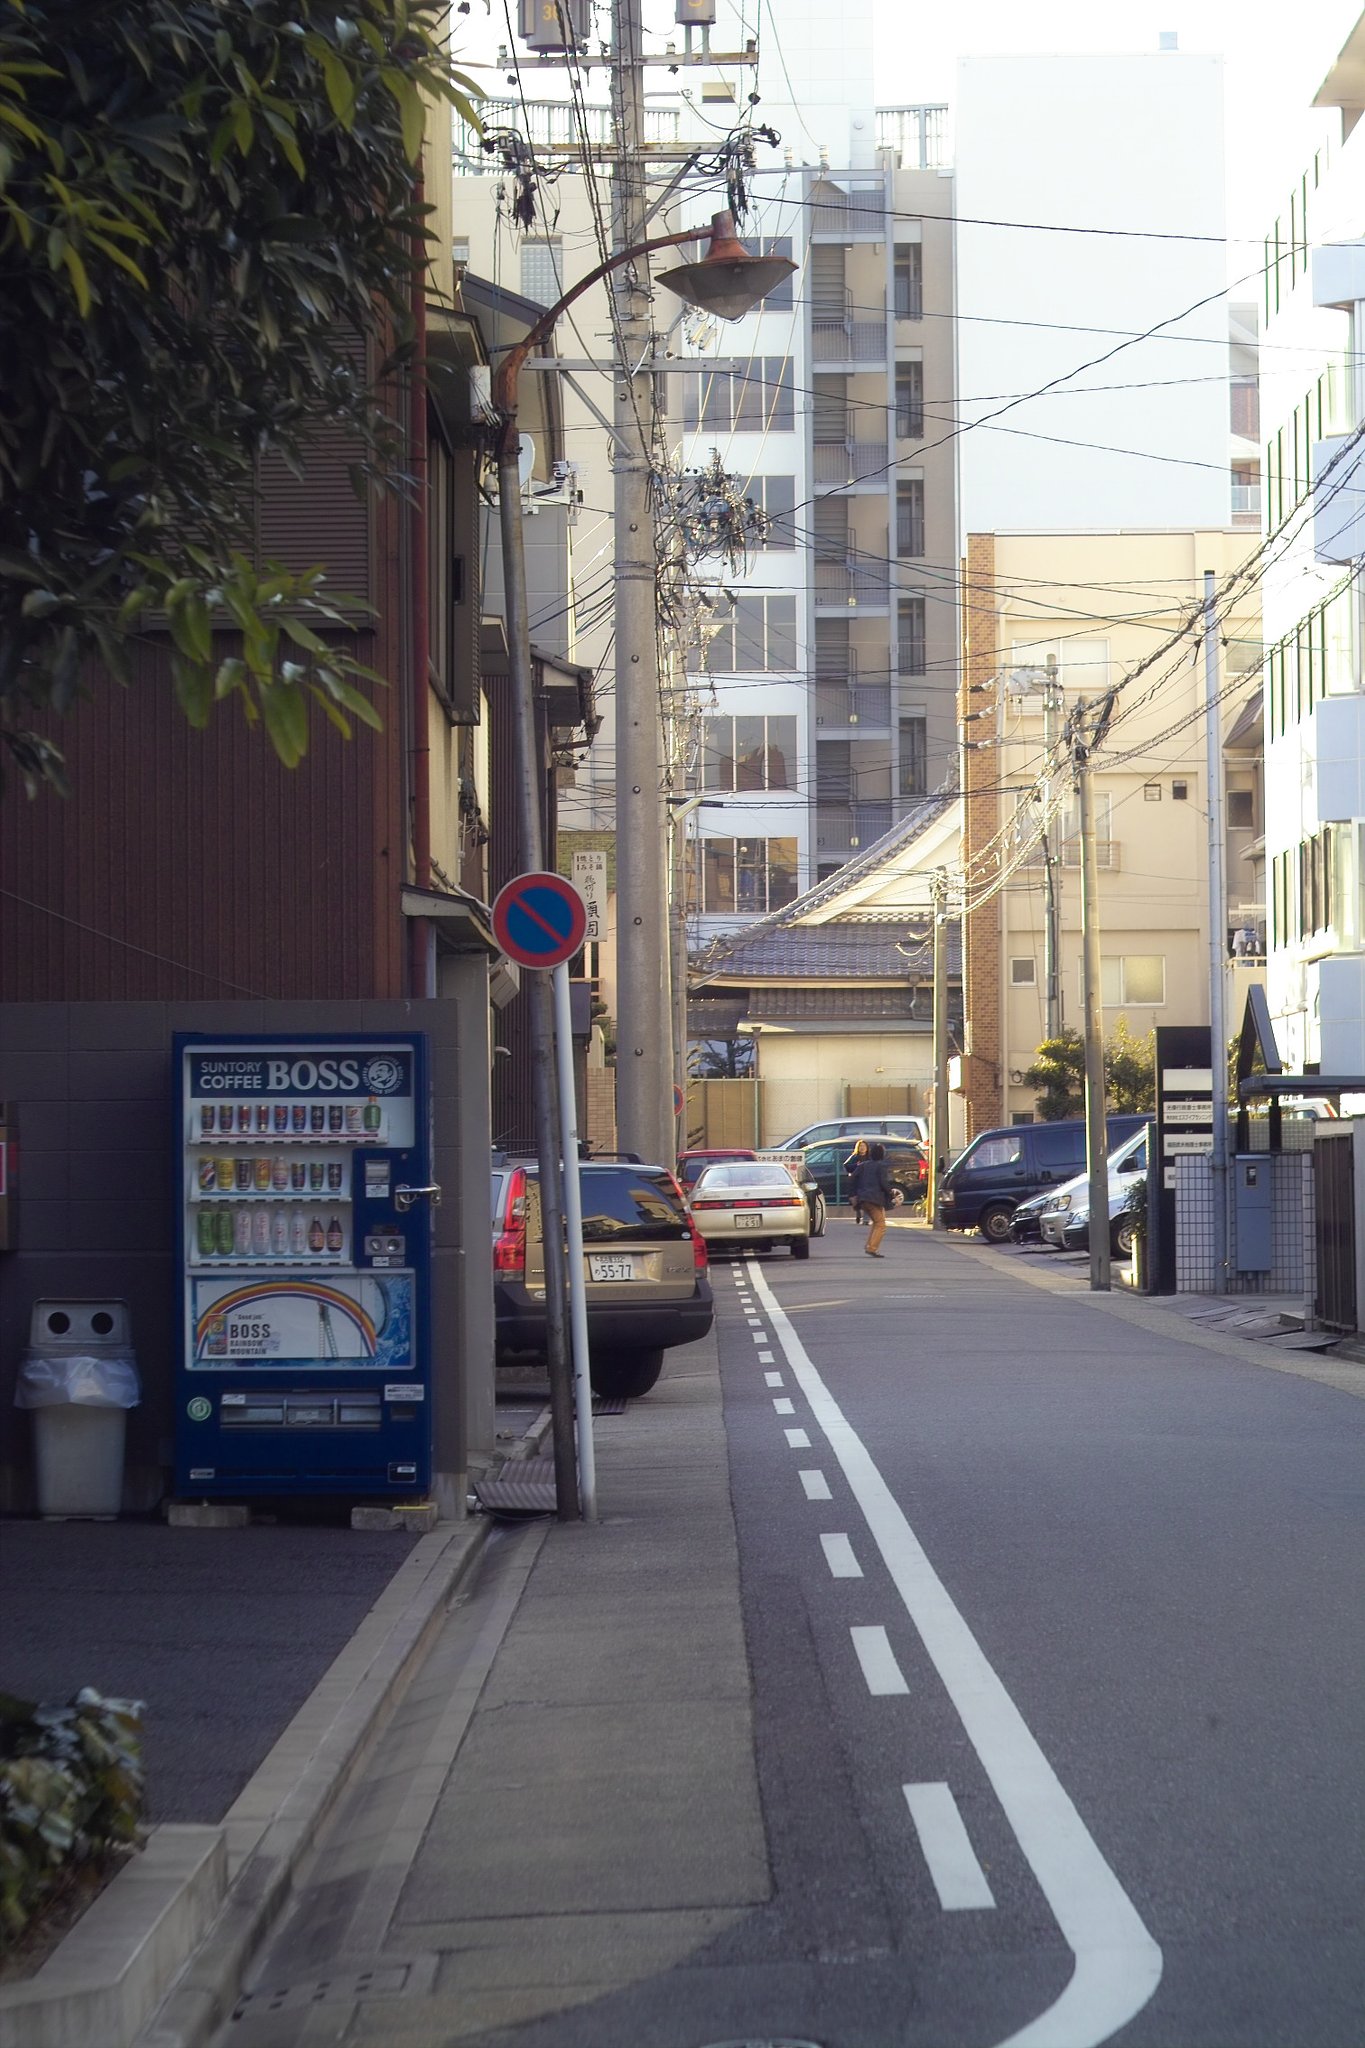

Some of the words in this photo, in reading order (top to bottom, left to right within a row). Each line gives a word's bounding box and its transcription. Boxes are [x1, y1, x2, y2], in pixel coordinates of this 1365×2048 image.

[201, 1062, 262, 1073] SUNTORY
[200, 1075, 262, 1089] COFFEE
[266, 1060, 360, 1090] BOSS
[600, 1264, 631, 1278] 55-77
[230, 1324, 271, 1339] BOSS
